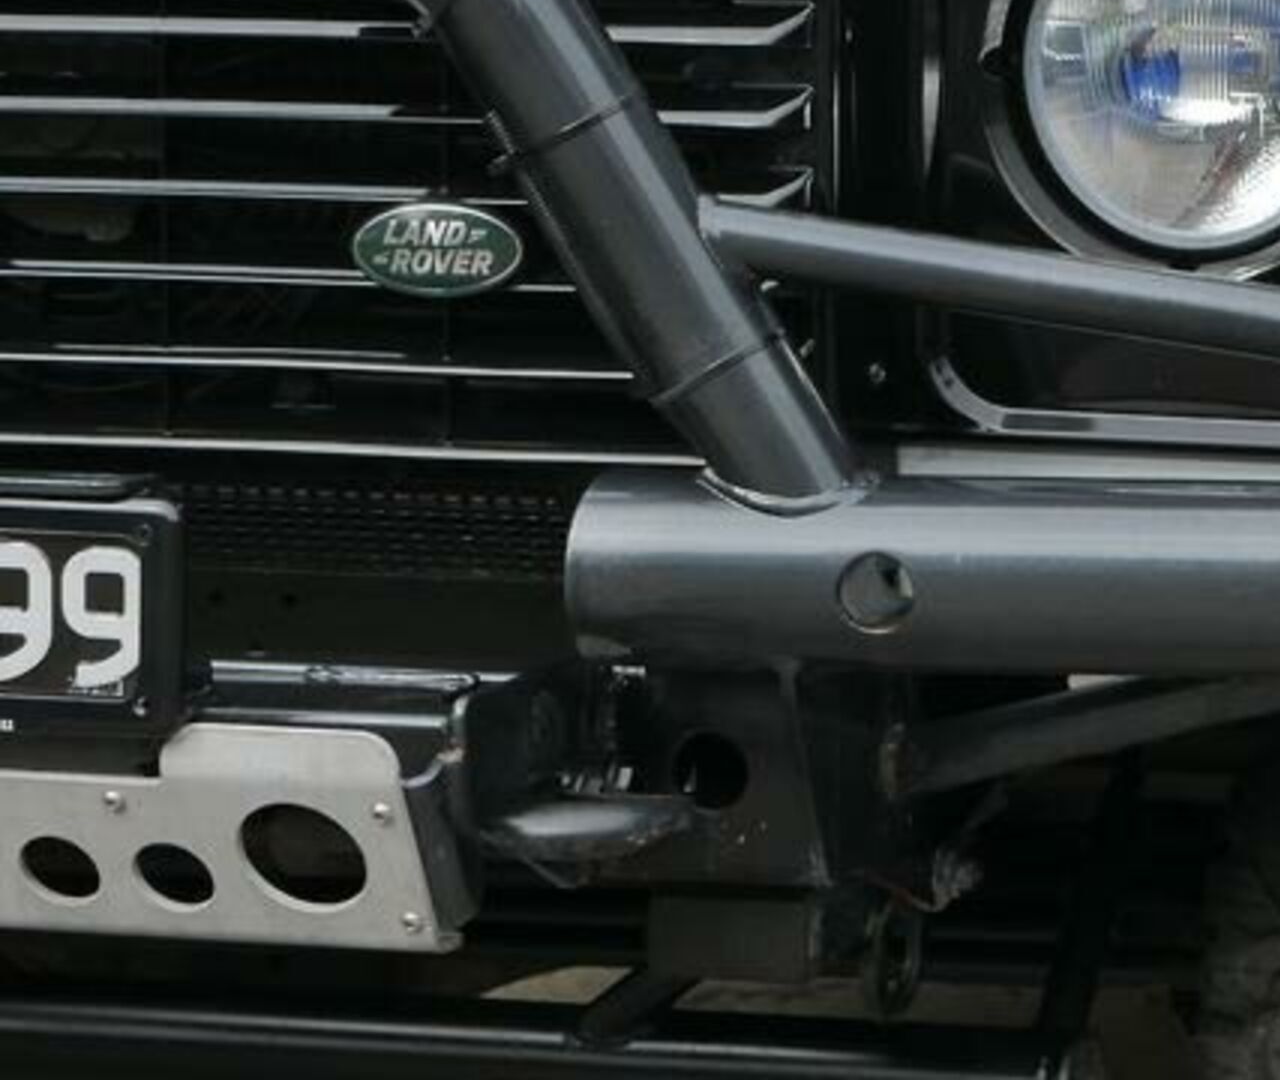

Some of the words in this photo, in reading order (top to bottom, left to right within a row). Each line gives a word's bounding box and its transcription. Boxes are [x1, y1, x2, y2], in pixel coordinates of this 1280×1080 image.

[383, 219, 466, 246] LAND
[389, 248, 493, 275] ROVER
[0, 540, 142, 688] 99
